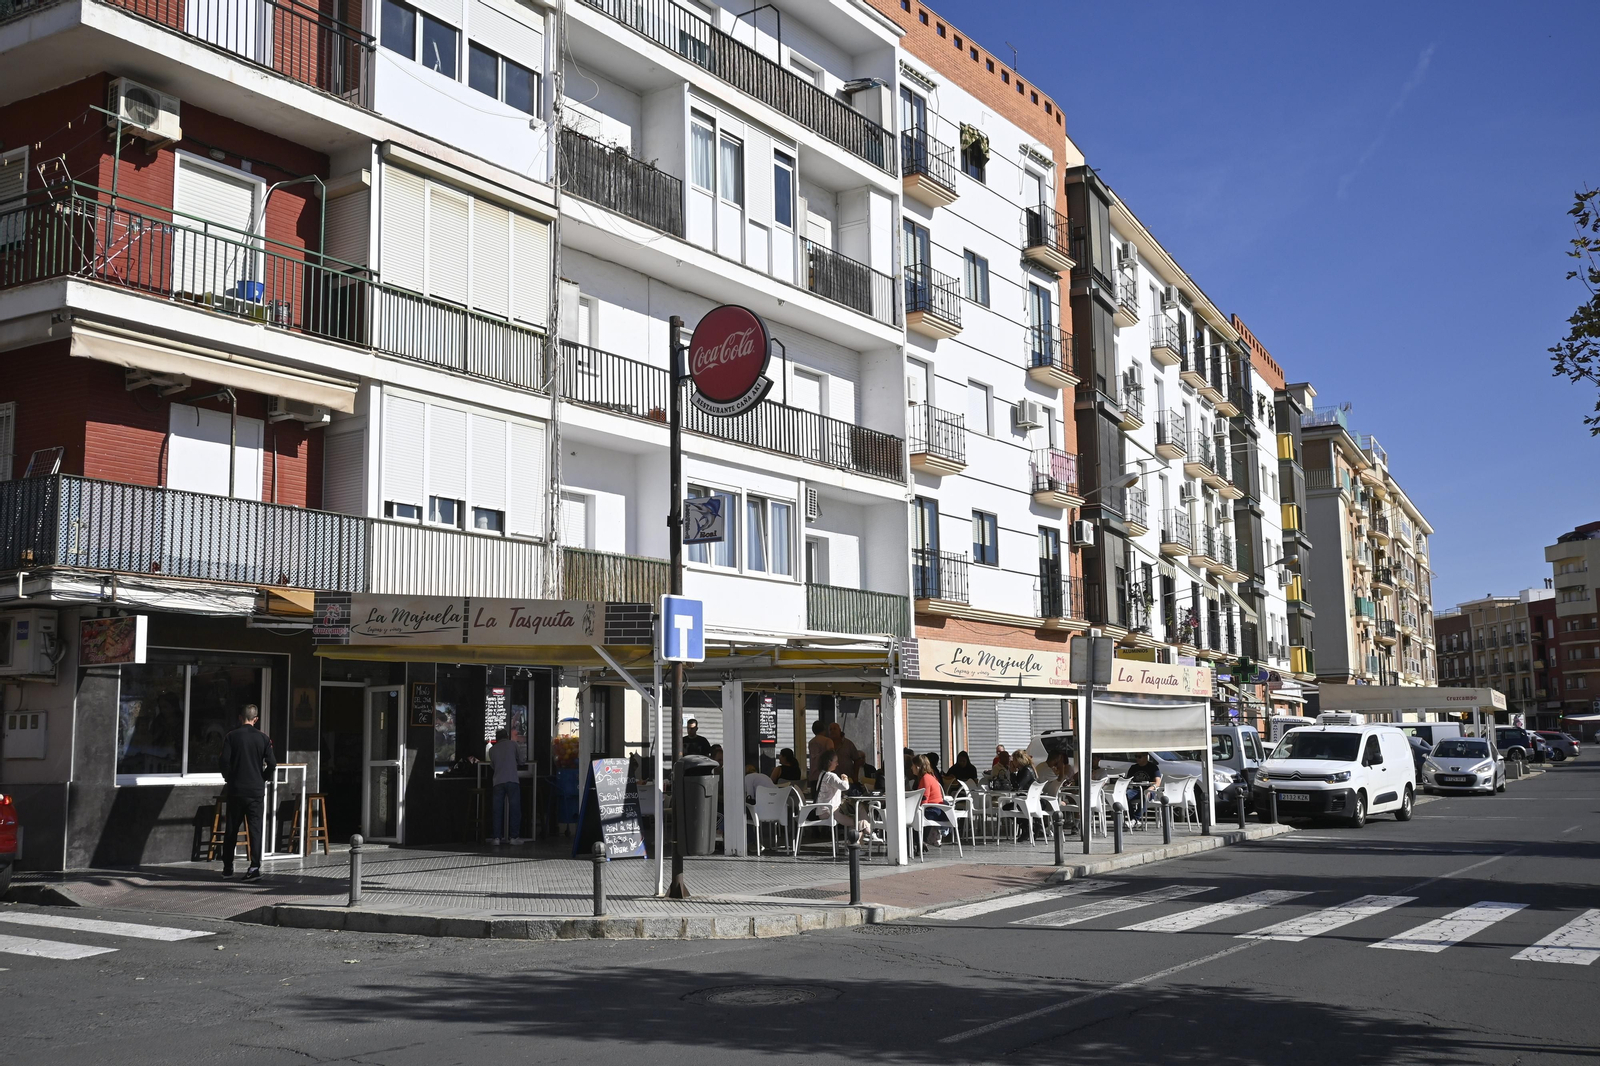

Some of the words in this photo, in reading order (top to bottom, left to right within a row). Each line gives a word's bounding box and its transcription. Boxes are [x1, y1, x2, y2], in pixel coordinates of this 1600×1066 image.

[692, 325, 757, 376] Coca-Cola
[696, 397, 736, 414] RESTAURANTE
[736, 396, 752, 410] CAÑA
[752, 382, 762, 397] AKI
[365, 608, 386, 624] La
[392, 604, 463, 630] Majuela
[474, 607, 498, 628] La
[508, 606, 575, 634] Tasquita
[313, 626, 348, 636] Cruzcampo
[950, 648, 973, 665] La
[978, 650, 1043, 675] Majuela
[1048, 676, 1071, 687] Cruzcamp
[1118, 668, 1134, 683] La
[1140, 670, 1179, 690] Tasquita
